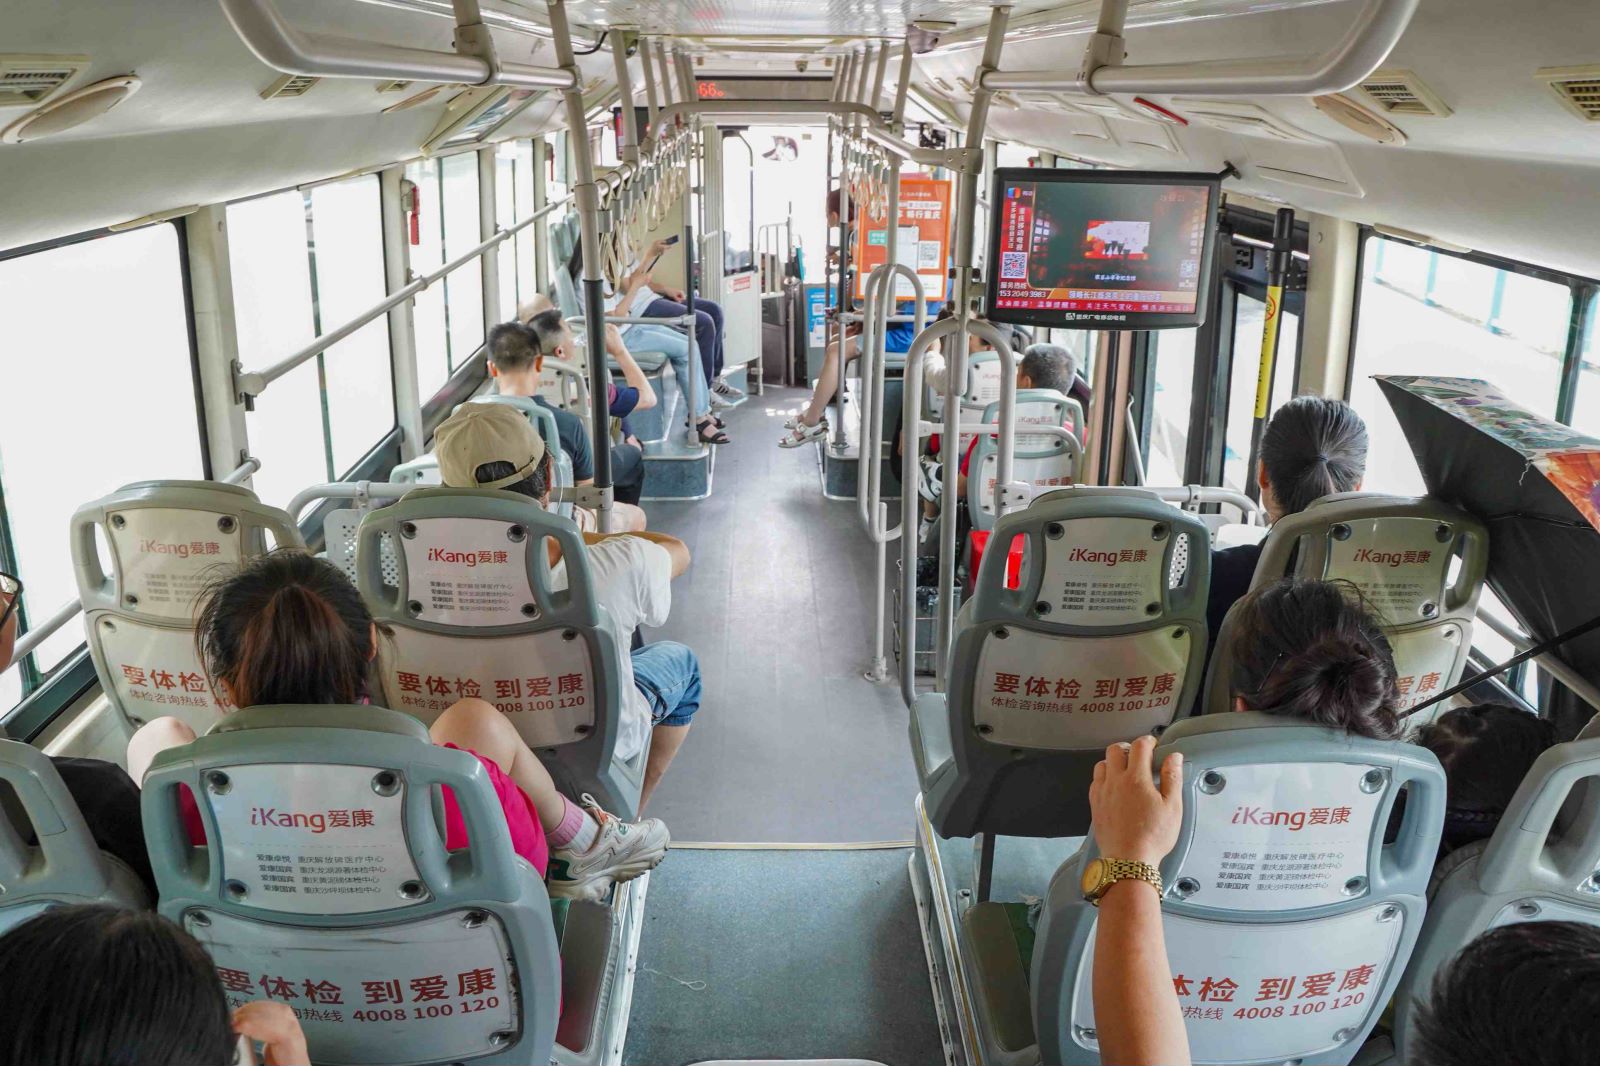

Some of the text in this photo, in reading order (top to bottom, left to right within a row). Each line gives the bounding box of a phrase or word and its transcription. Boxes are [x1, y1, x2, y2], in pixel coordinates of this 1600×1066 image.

[428, 548, 508, 567] iKang爱康
[1068, 548, 1147, 566] iKang爱康
[1353, 548, 1431, 567] iKang爱康
[121, 664, 207, 692] 要体检
[396, 670, 584, 699] 要体检 到爱康
[993, 672, 1176, 699] 要体检 到爱康
[491, 703, 523, 713] 008
[528, 700, 554, 711] 100
[559, 696, 585, 708] 120
[991, 696, 1170, 713] 体检咨询热线 4008 100 120
[251, 808, 376, 833] iKang爱康
[1231, 806, 1352, 831] iKang爱康
[216, 966, 497, 1004] 要体检 到爱康
[1255, 963, 1377, 1002] 到爱康
[352, 1008, 407, 1022] 4008
[414, 1004, 453, 1019] 100
[462, 996, 499, 1013] 120
[1233, 1006, 1283, 1020] 4008
[1290, 1001, 1326, 1016] 100
[1330, 992, 1365, 1010] 120
